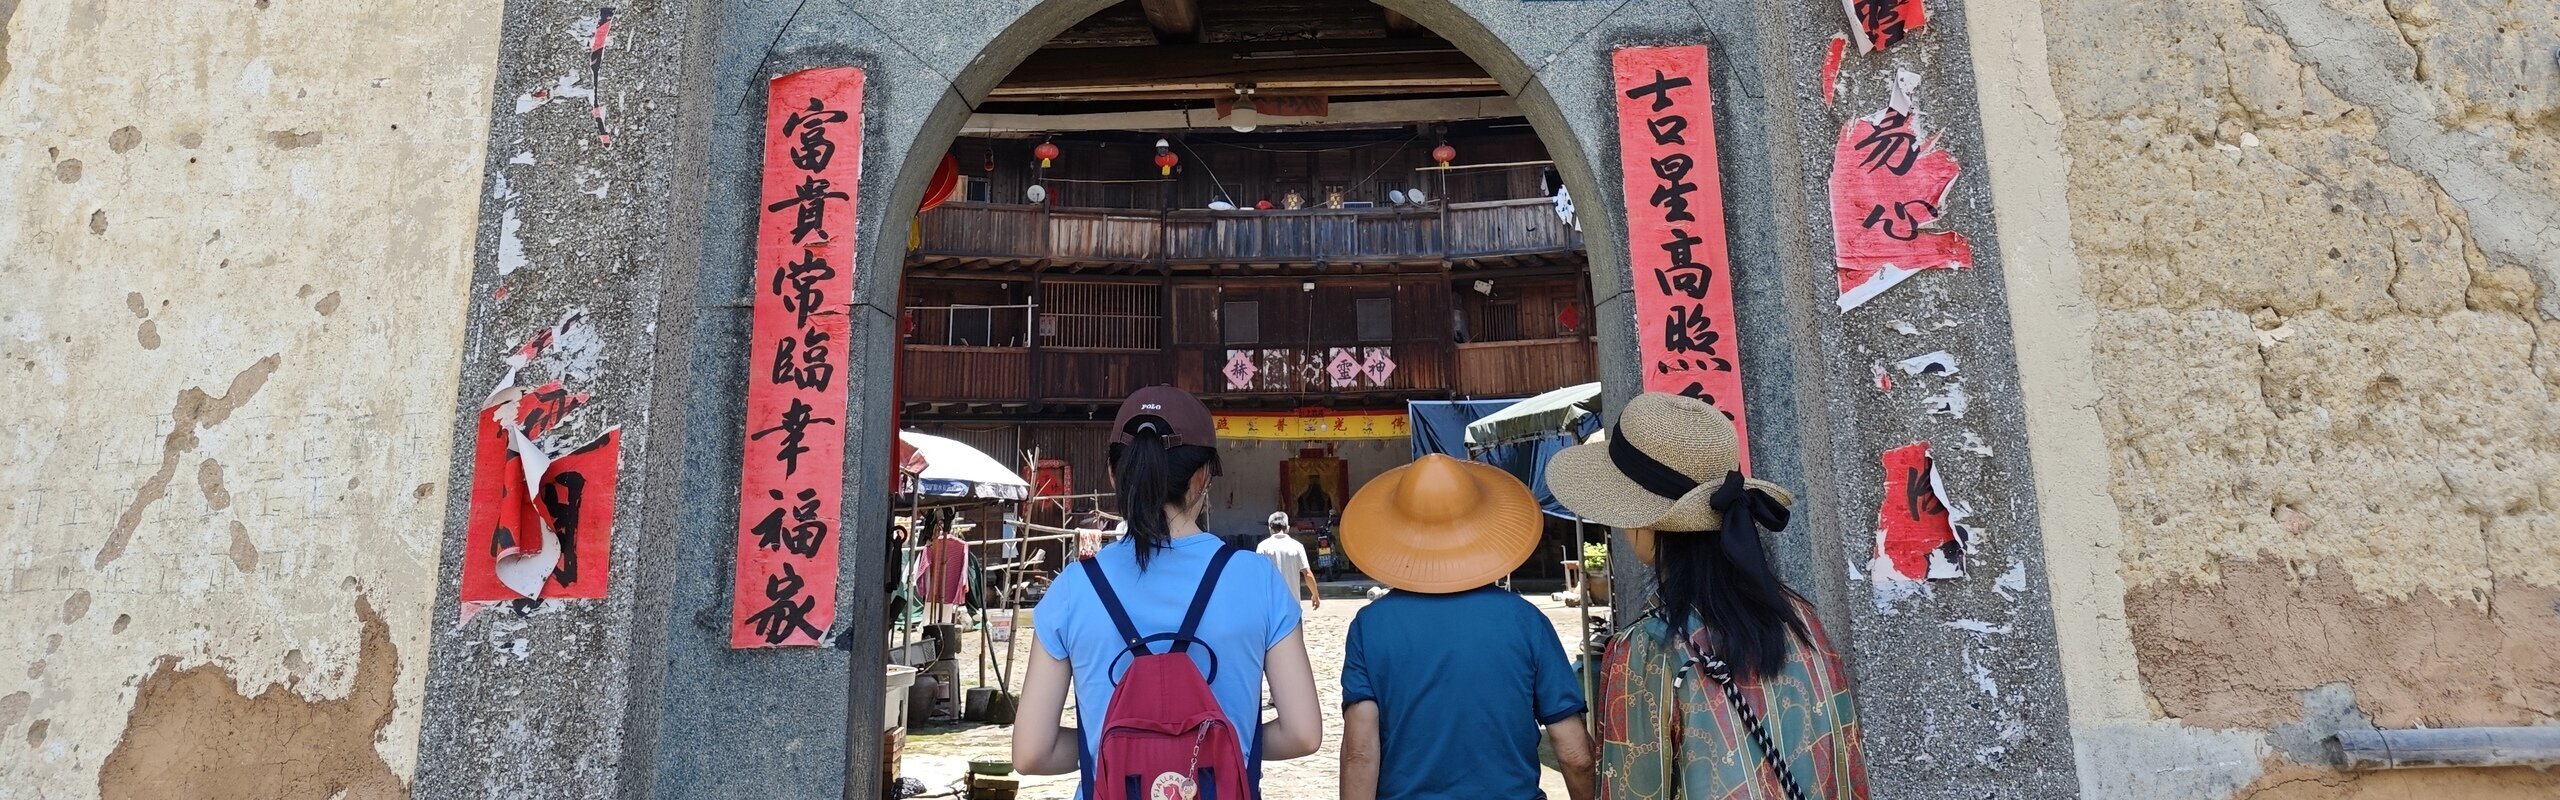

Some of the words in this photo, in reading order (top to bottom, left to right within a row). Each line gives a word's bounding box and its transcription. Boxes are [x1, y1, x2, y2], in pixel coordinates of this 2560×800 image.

[744, 98, 849, 645] 富貴常臨幸福家
